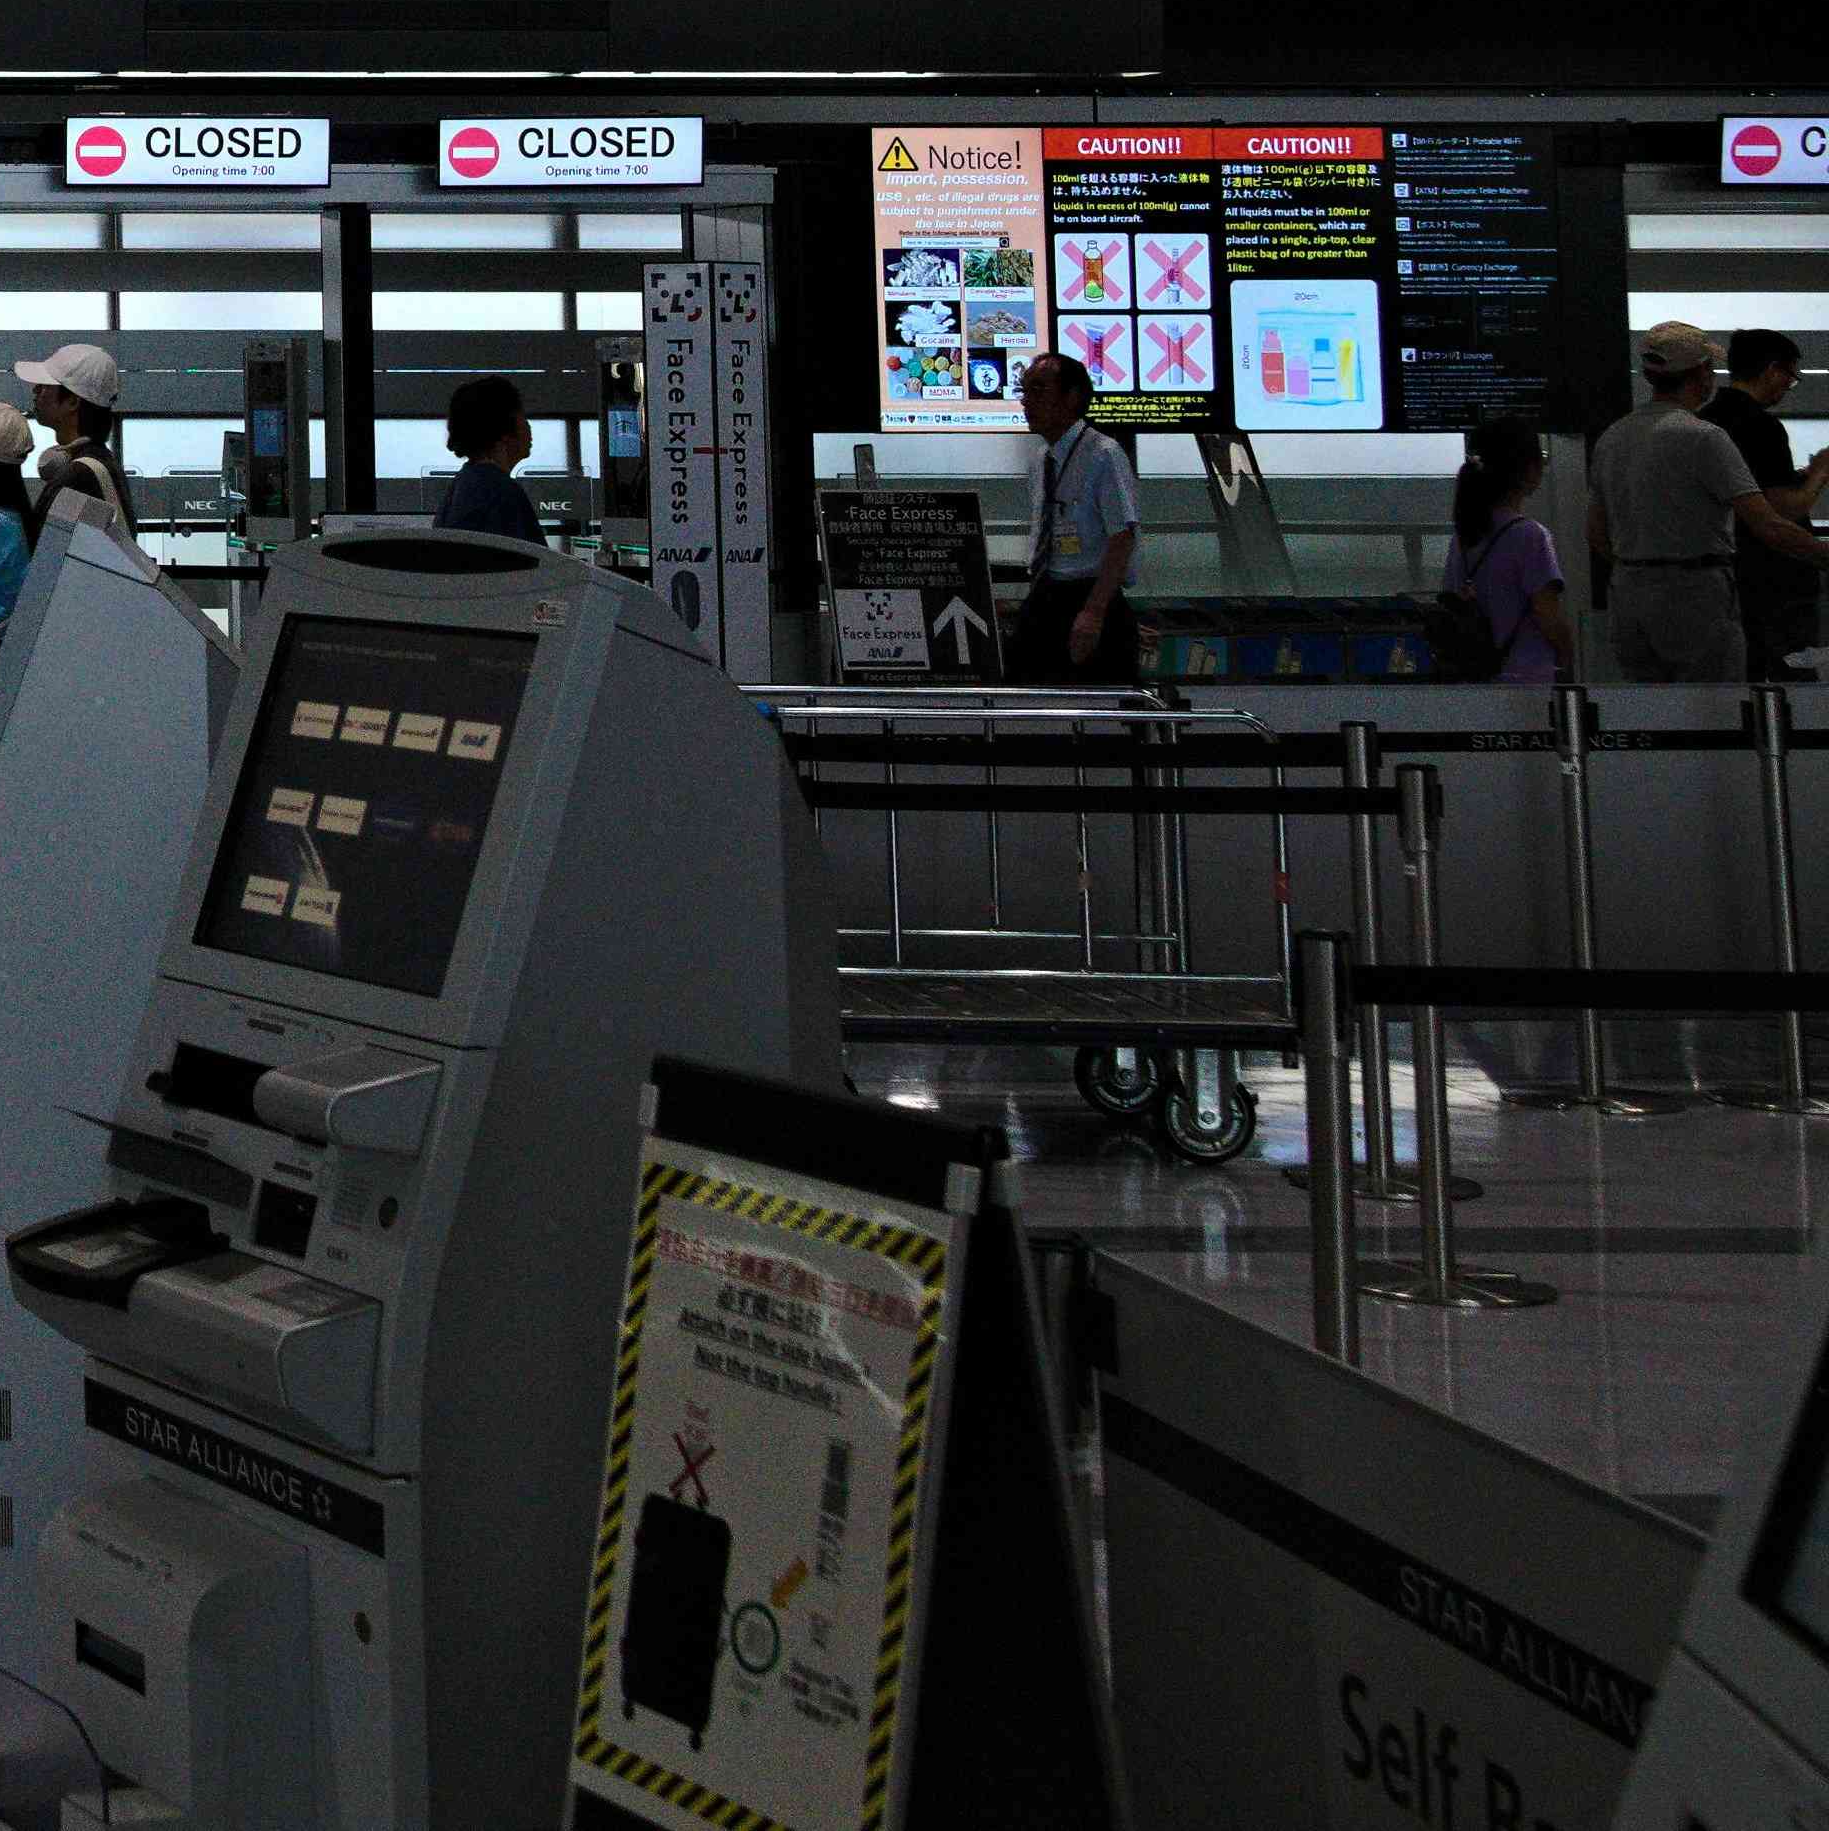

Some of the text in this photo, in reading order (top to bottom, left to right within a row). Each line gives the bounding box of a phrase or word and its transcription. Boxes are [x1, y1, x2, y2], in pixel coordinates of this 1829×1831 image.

[145, 126, 302, 159] CLOSED
[518, 126, 675, 159] CLOSED
[1077, 137, 1181, 156] CAUTION!!
[1247, 136, 1352, 155] CAUTION!!
[929, 141, 1021, 170] Notice!
[545, 164, 649, 178] Opening time 7:00
[1053, 202, 1083, 211] Liquids
[1086, 202, 1094, 210] in
[1126, 202, 1136, 210] of
[1138, 201, 1177, 212] 100ml(g)
[1179, 202, 1210, 211] cannot
[1224, 207, 1370, 218] All liquids must be in 100ml or
[1053, 214, 1062, 222] be
[1080, 214, 1106, 222] board
[1109, 214, 1143, 222] aircraft.
[664, 339, 696, 525] Face Express
[731, 339, 752, 526] Face Express
[185, 501, 217, 511] NEC
[540, 501, 572, 511] NEC
[656, 548, 694, 564] ANA
[724, 548, 753, 564] ANA
[842, 628, 921, 643] Face Express
[1470, 733, 1629, 750] STAR ALNCE
[124, 1407, 303, 1512] STAR ALLIANCE
